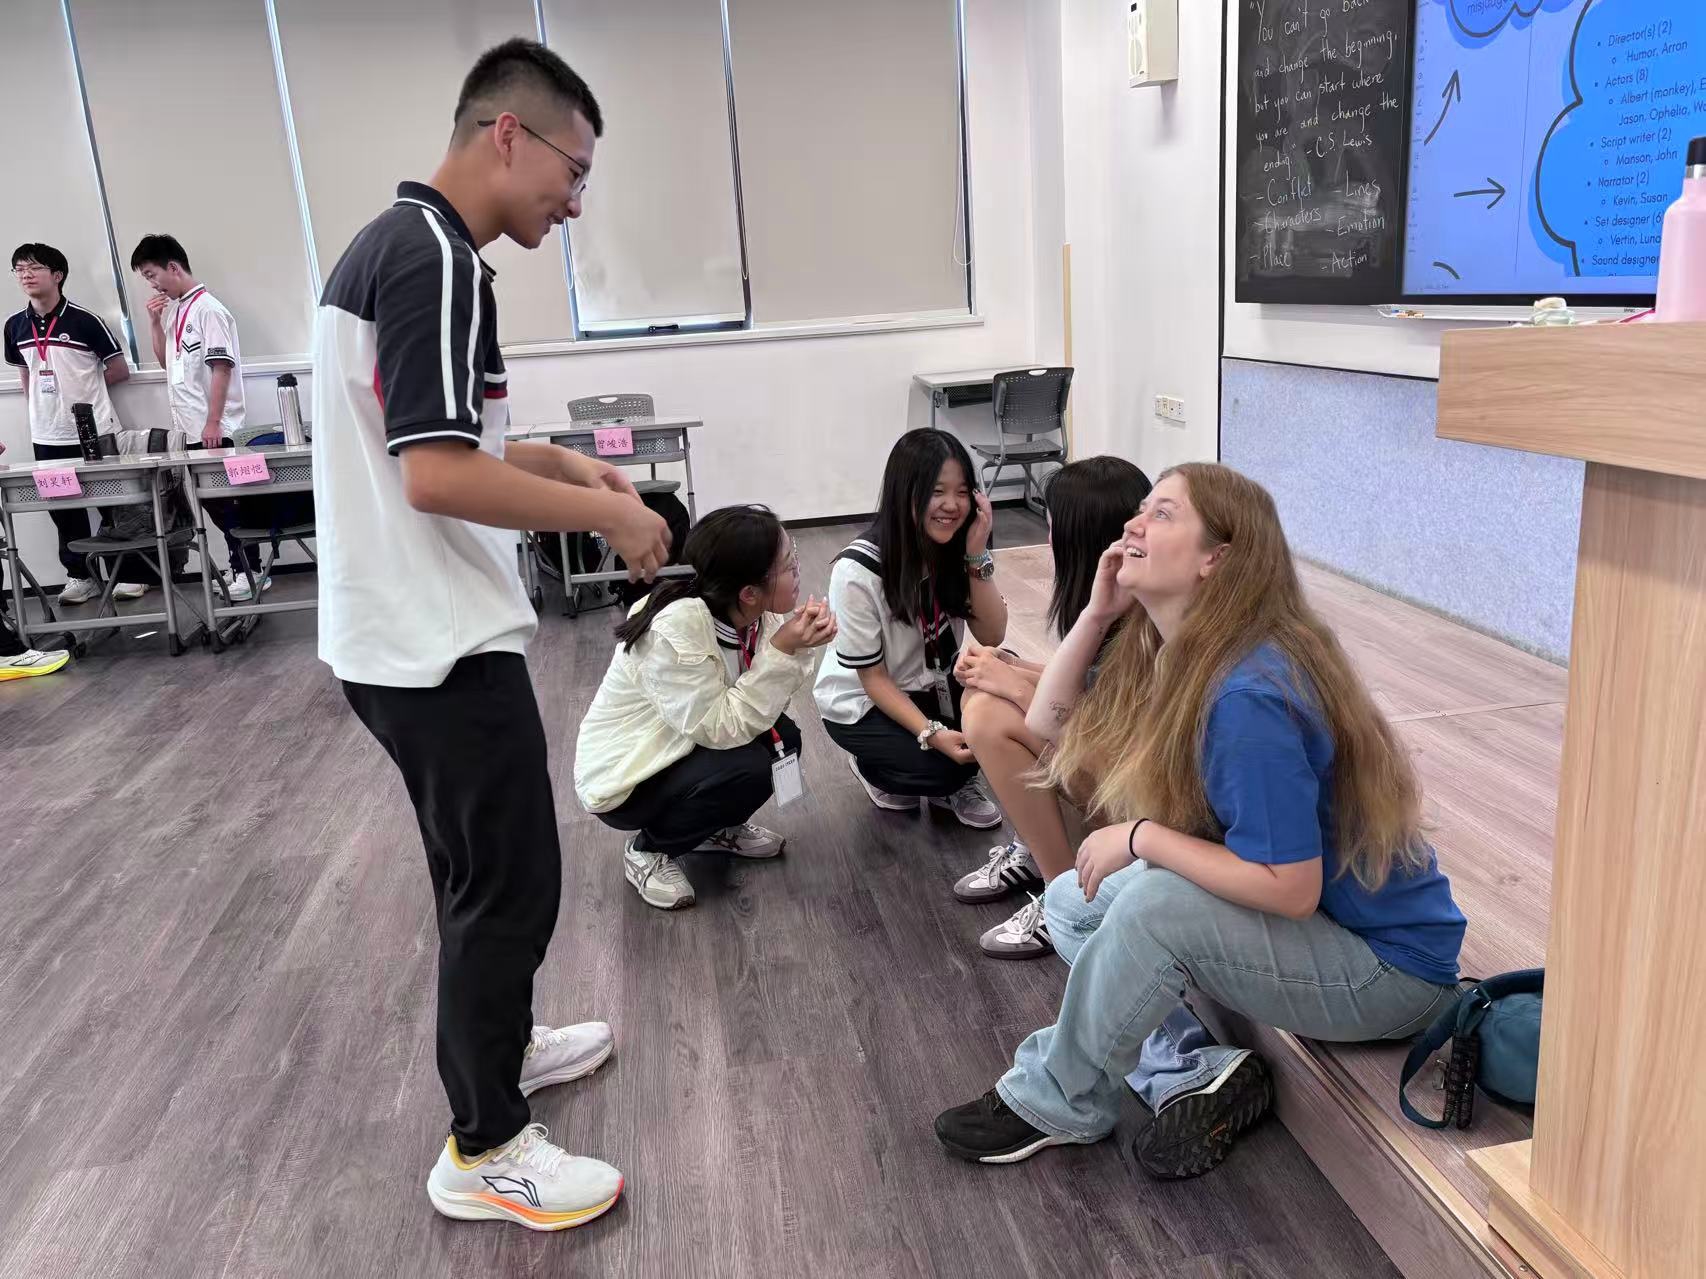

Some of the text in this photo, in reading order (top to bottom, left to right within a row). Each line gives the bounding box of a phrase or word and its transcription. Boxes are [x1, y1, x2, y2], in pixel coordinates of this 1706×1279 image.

[1319, 8, 1331, 38] go
[1608, 19, 1672, 47] Director(s) (2)
[1255, 56, 1271, 78] and
[1279, 54, 1309, 85] change
[1320, 38, 1337, 62] the
[1604, 67, 1649, 88] Actors (8)
[1255, 70, 1384, 124] but you can start where
[1620, 90, 1648, 104] Albert
[1256, 91, 1399, 152] you are and change the
[1343, 130, 1373, 147] Lewis
[1601, 127, 1672, 150] Script writer (2)
[1656, 148, 1678, 161] John
[1598, 170, 1650, 187] Narrator (2)
[1640, 192, 1668, 204] Susan
[1595, 215, 1609, 228] Set
[1612, 213, 1650, 228] designer
[1592, 253, 1619, 266] Sound
